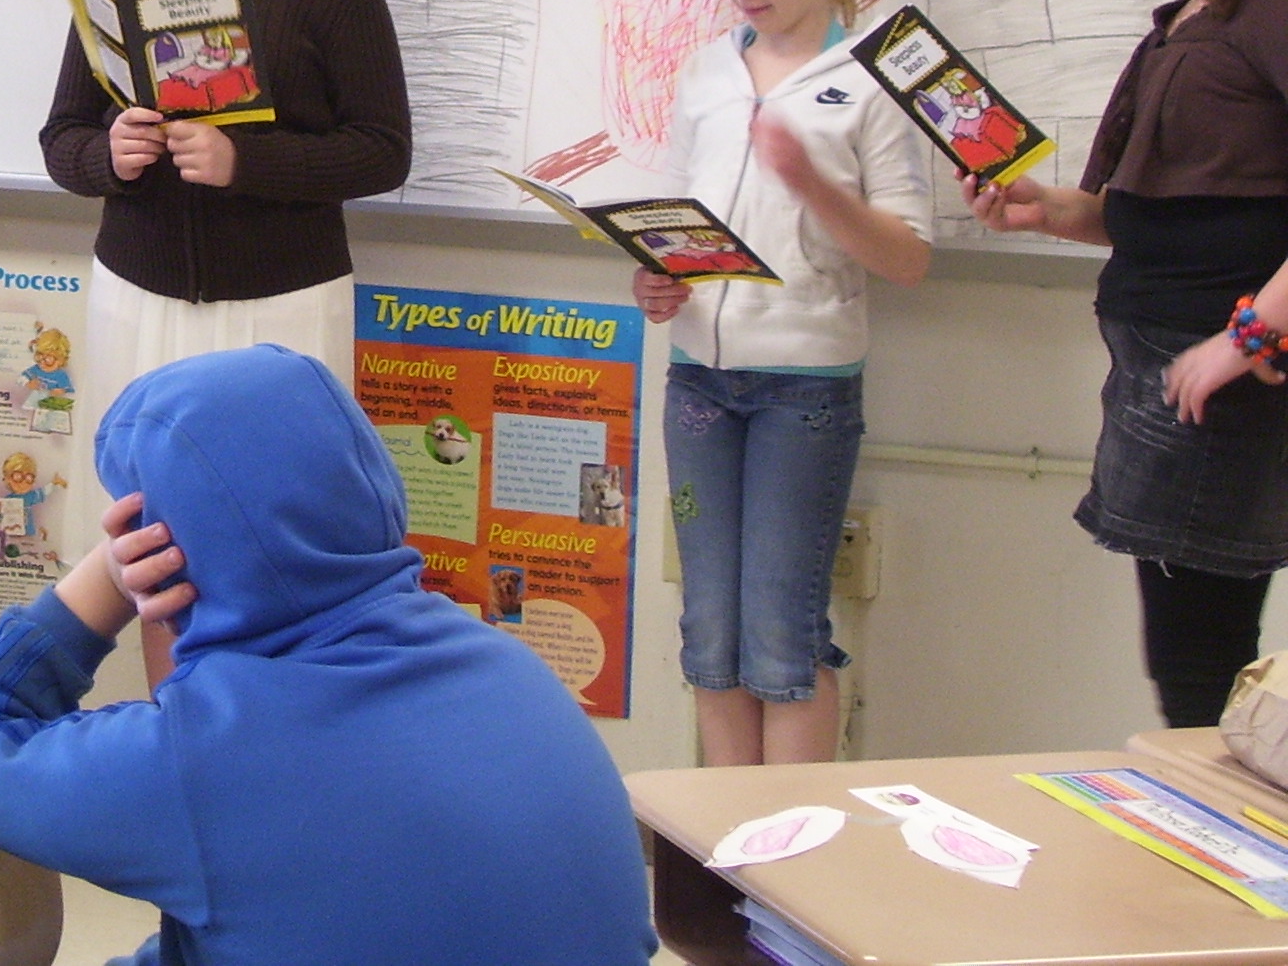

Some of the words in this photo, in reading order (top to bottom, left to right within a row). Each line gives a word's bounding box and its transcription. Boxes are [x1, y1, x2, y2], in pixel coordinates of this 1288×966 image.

[168, 5, 213, 21] Beauty
[889, 40, 922, 67] Sleepless
[902, 55, 930, 76] Beauty
[373, 293, 462, 332] Types
[466, 309, 495, 336] of
[498, 304, 617, 349] Writing
[361, 352, 458, 381] Narrative
[493, 356, 602, 389] Expository
[489, 524, 597, 555] Persuasive
[527, 555, 572, 568] convince
